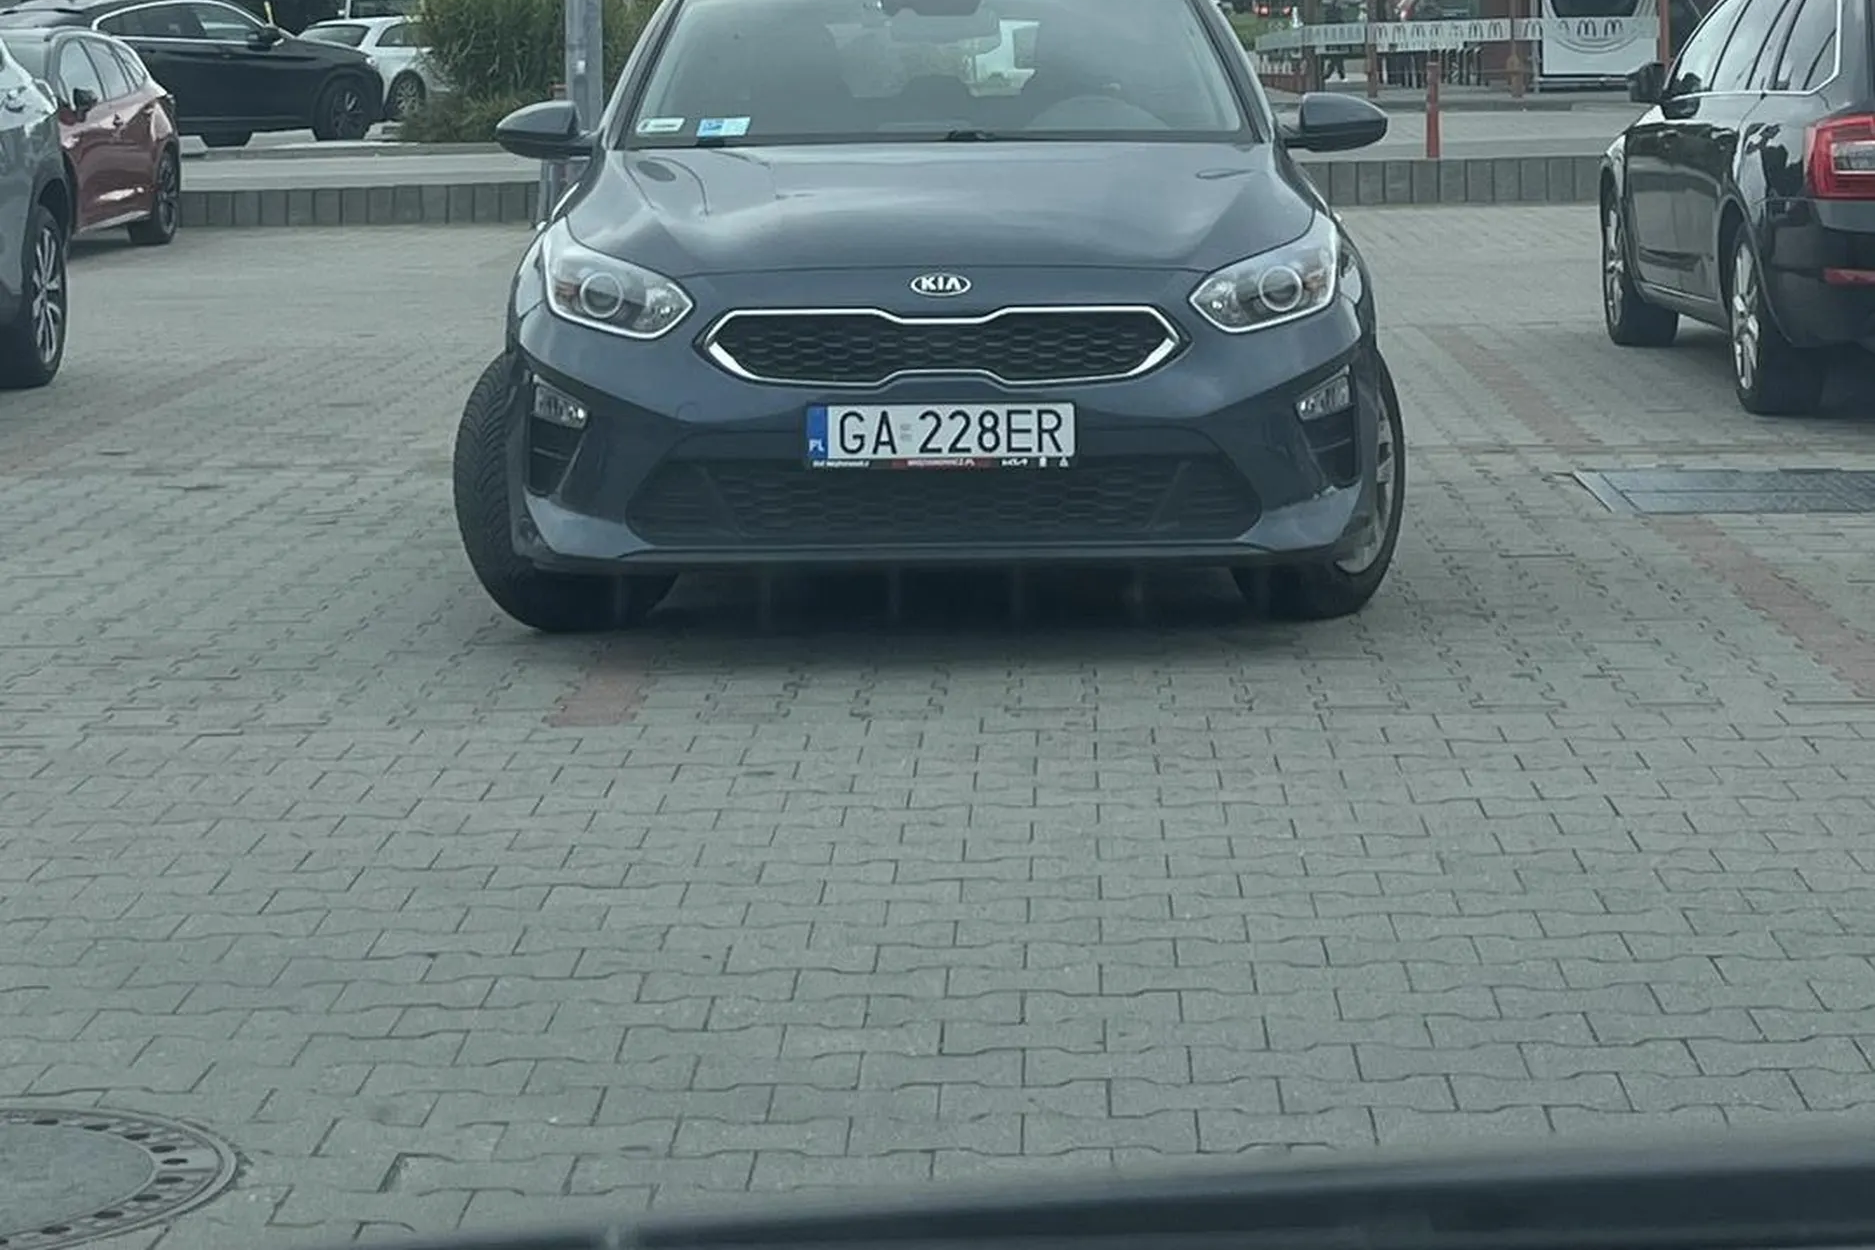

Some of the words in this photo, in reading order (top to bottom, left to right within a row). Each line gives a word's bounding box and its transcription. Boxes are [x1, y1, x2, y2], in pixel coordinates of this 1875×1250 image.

[921, 275, 962, 291] KIA
[839, 410, 898, 455] GA
[918, 409, 1064, 454] 228ER
